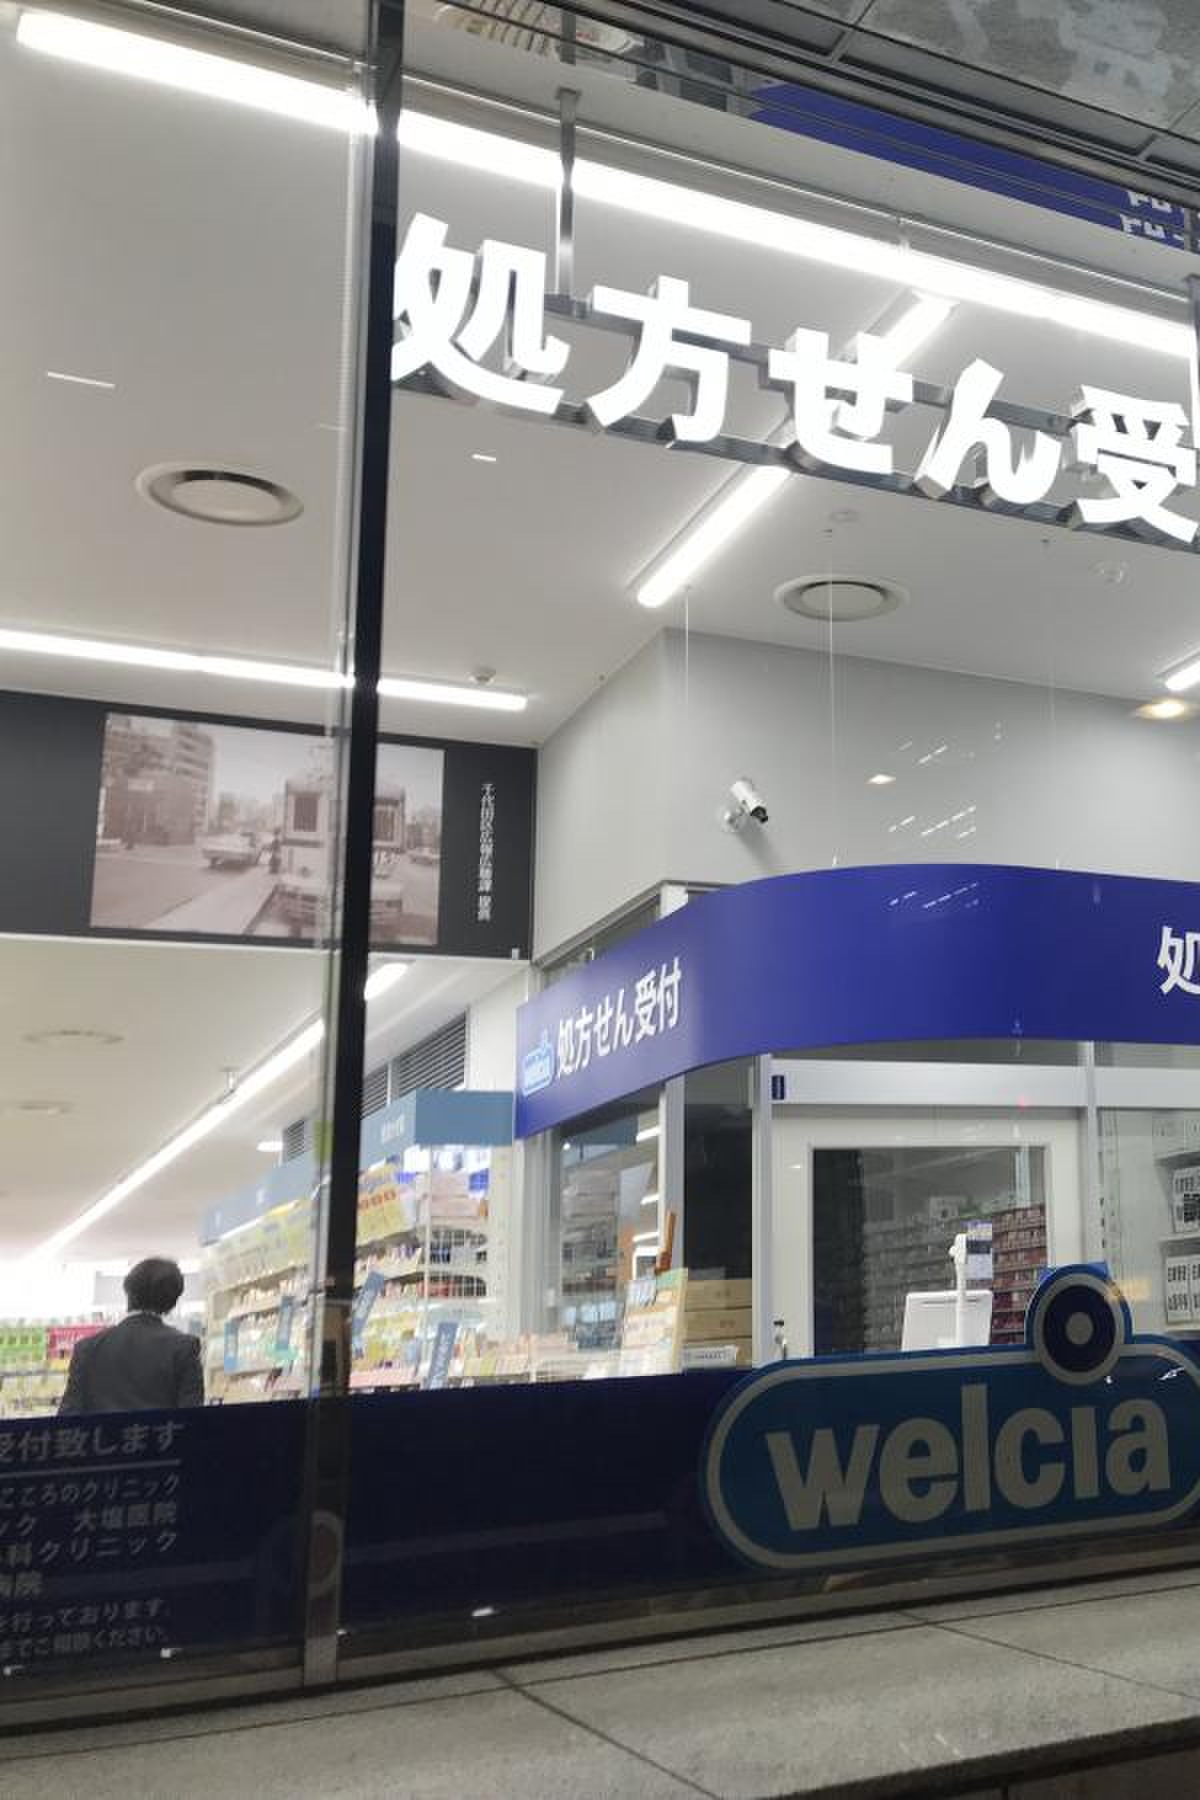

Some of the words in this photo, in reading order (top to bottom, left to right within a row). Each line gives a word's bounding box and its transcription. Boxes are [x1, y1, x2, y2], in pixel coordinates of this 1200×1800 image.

[558, 957, 682, 1078] 処方せん受付
[765, 1383, 1172, 1531] welcia
